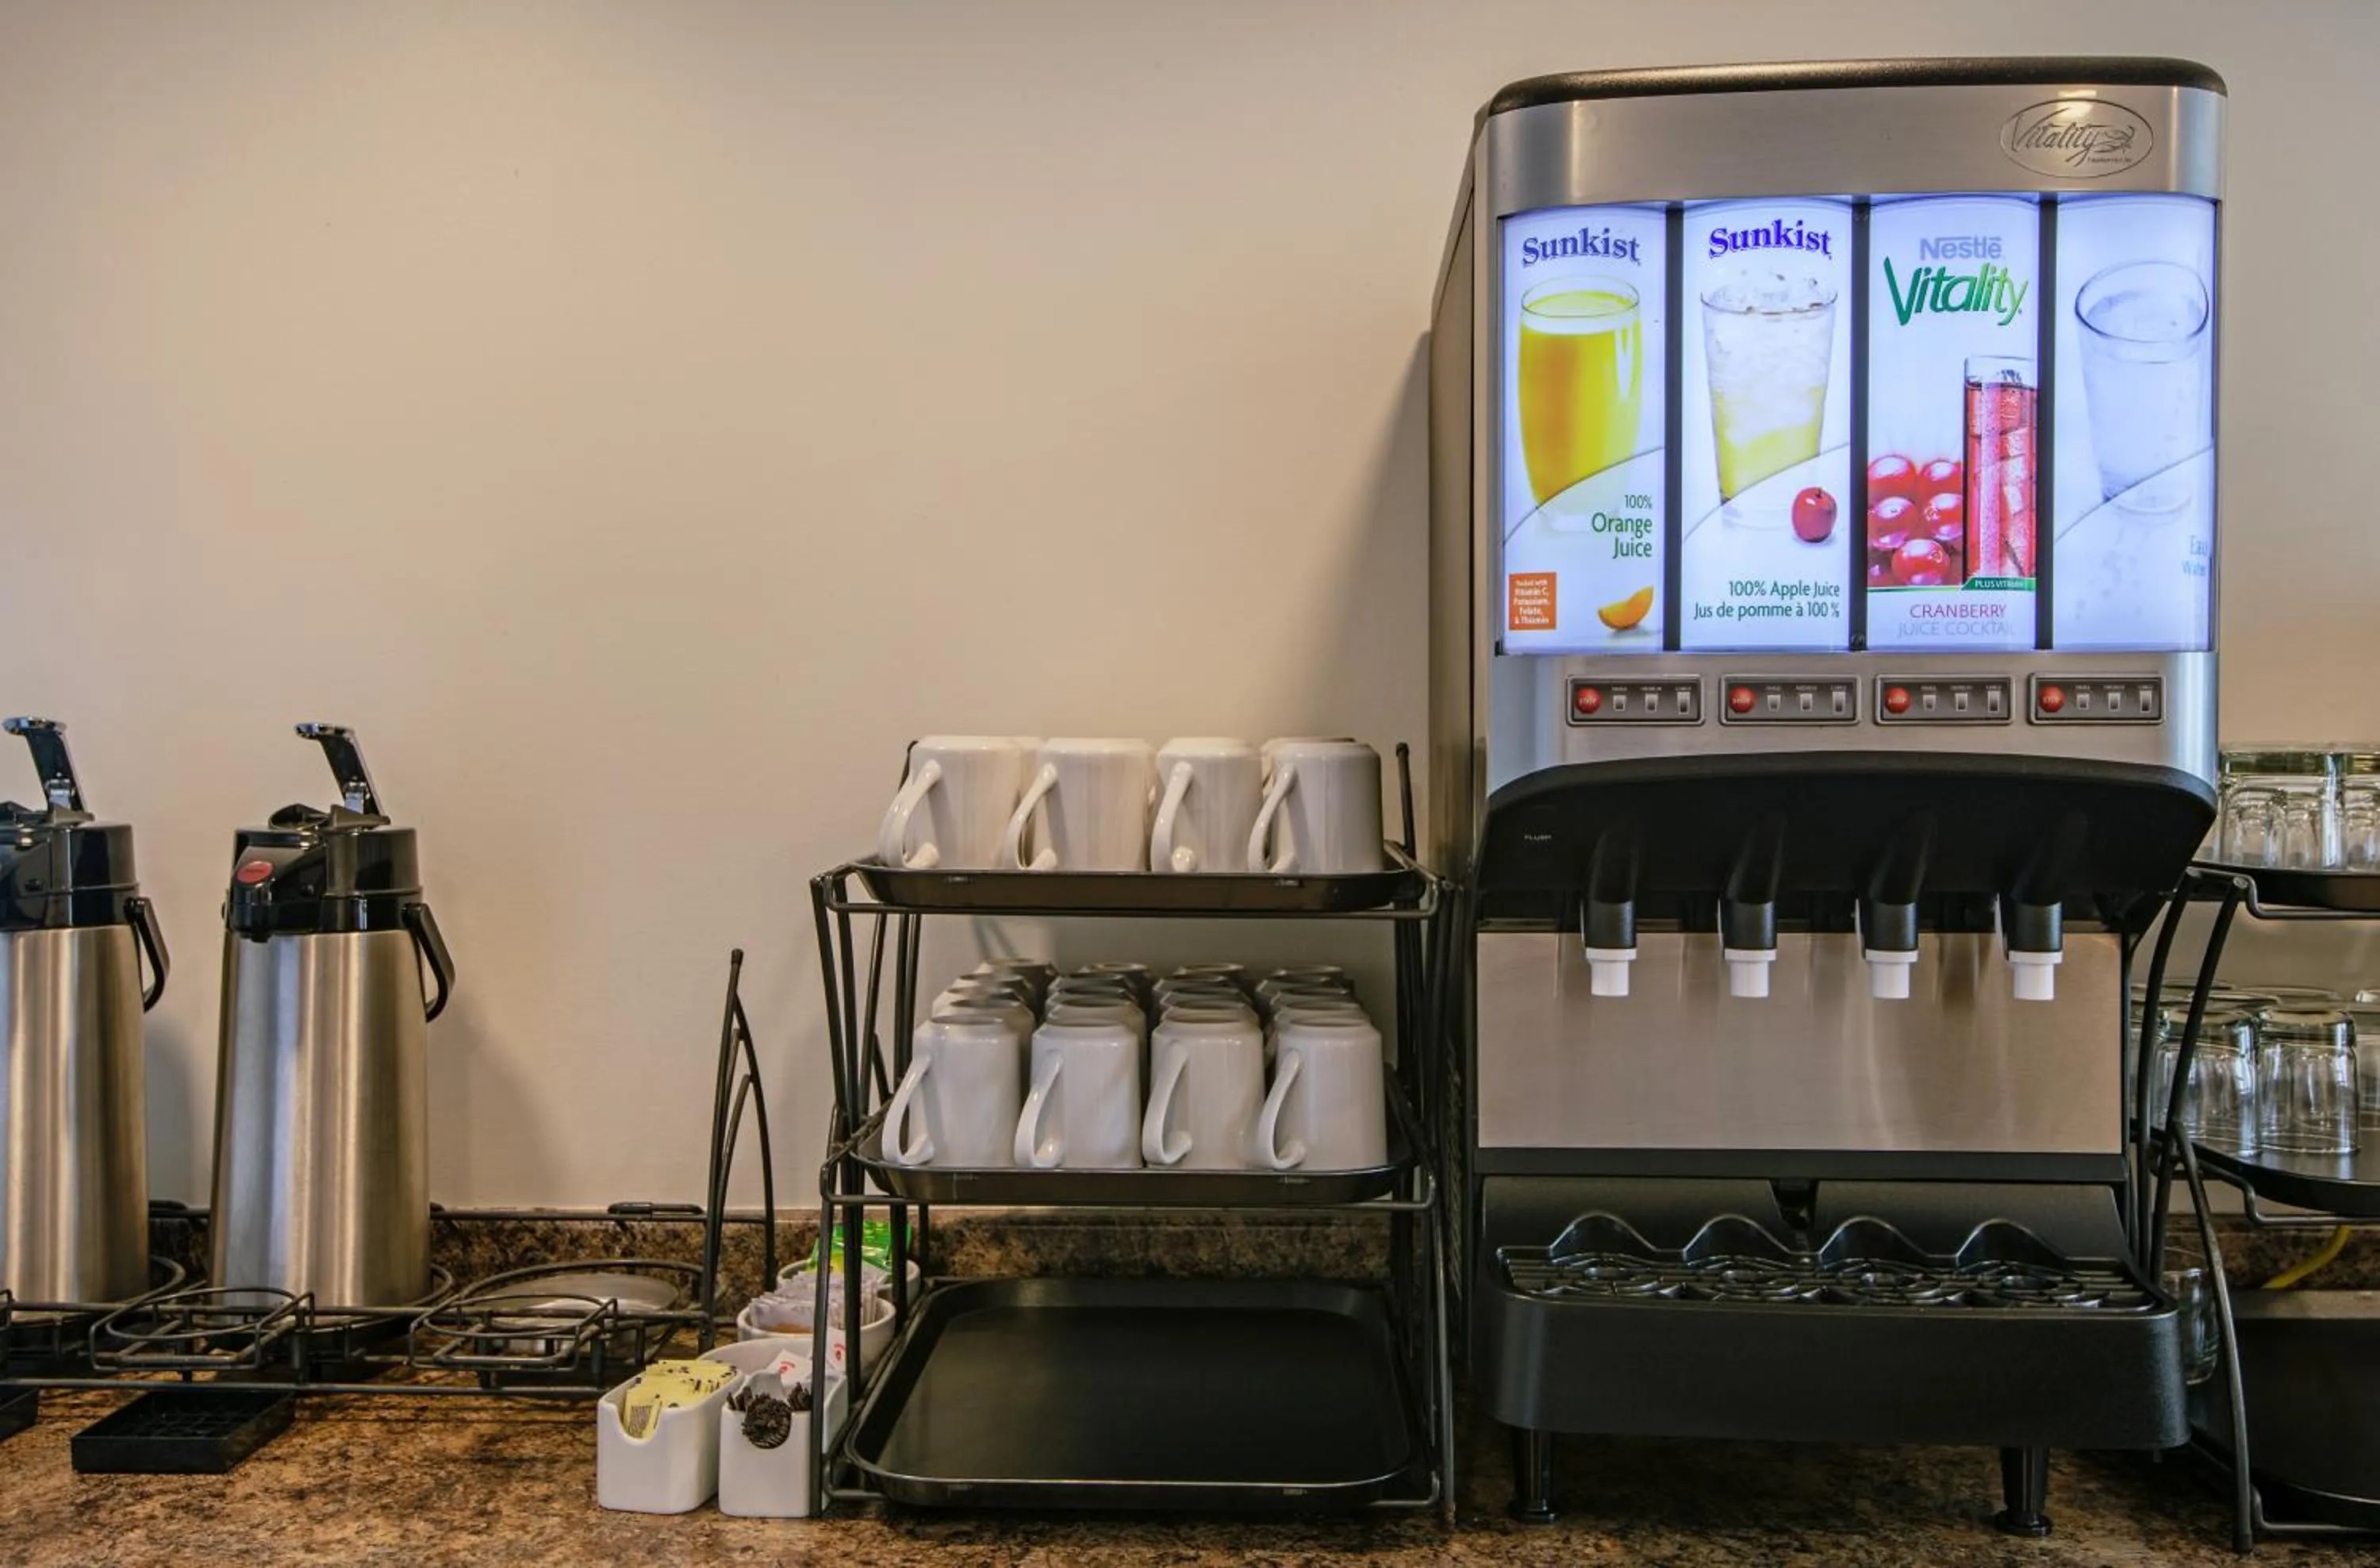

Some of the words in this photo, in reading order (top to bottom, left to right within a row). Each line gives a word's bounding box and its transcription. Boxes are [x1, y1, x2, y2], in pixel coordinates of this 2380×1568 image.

[2010, 107, 2100, 167] Vitality
[1522, 226, 1641, 267] Sunkist
[1709, 219, 1832, 260] Sunkist
[1883, 256, 2029, 326] Vitality
[1625, 494, 1652, 509] 100%
[1591, 512, 1653, 539] Orange
[1612, 536, 1652, 559] Juice
[1729, 580, 1766, 597] 100%
[1770, 580, 1810, 601] Apple
[1813, 582, 1841, 598] Juice
[1694, 601, 1713, 620] Jus
[1716, 601, 1734, 618] de
[1737, 604, 1793, 621] pomme
[1795, 602, 1804, 617] à
[1807, 601, 1829, 618] 100
[1910, 604, 2007, 619] CRANBERRY
[1897, 621, 1939, 639] JUICE
